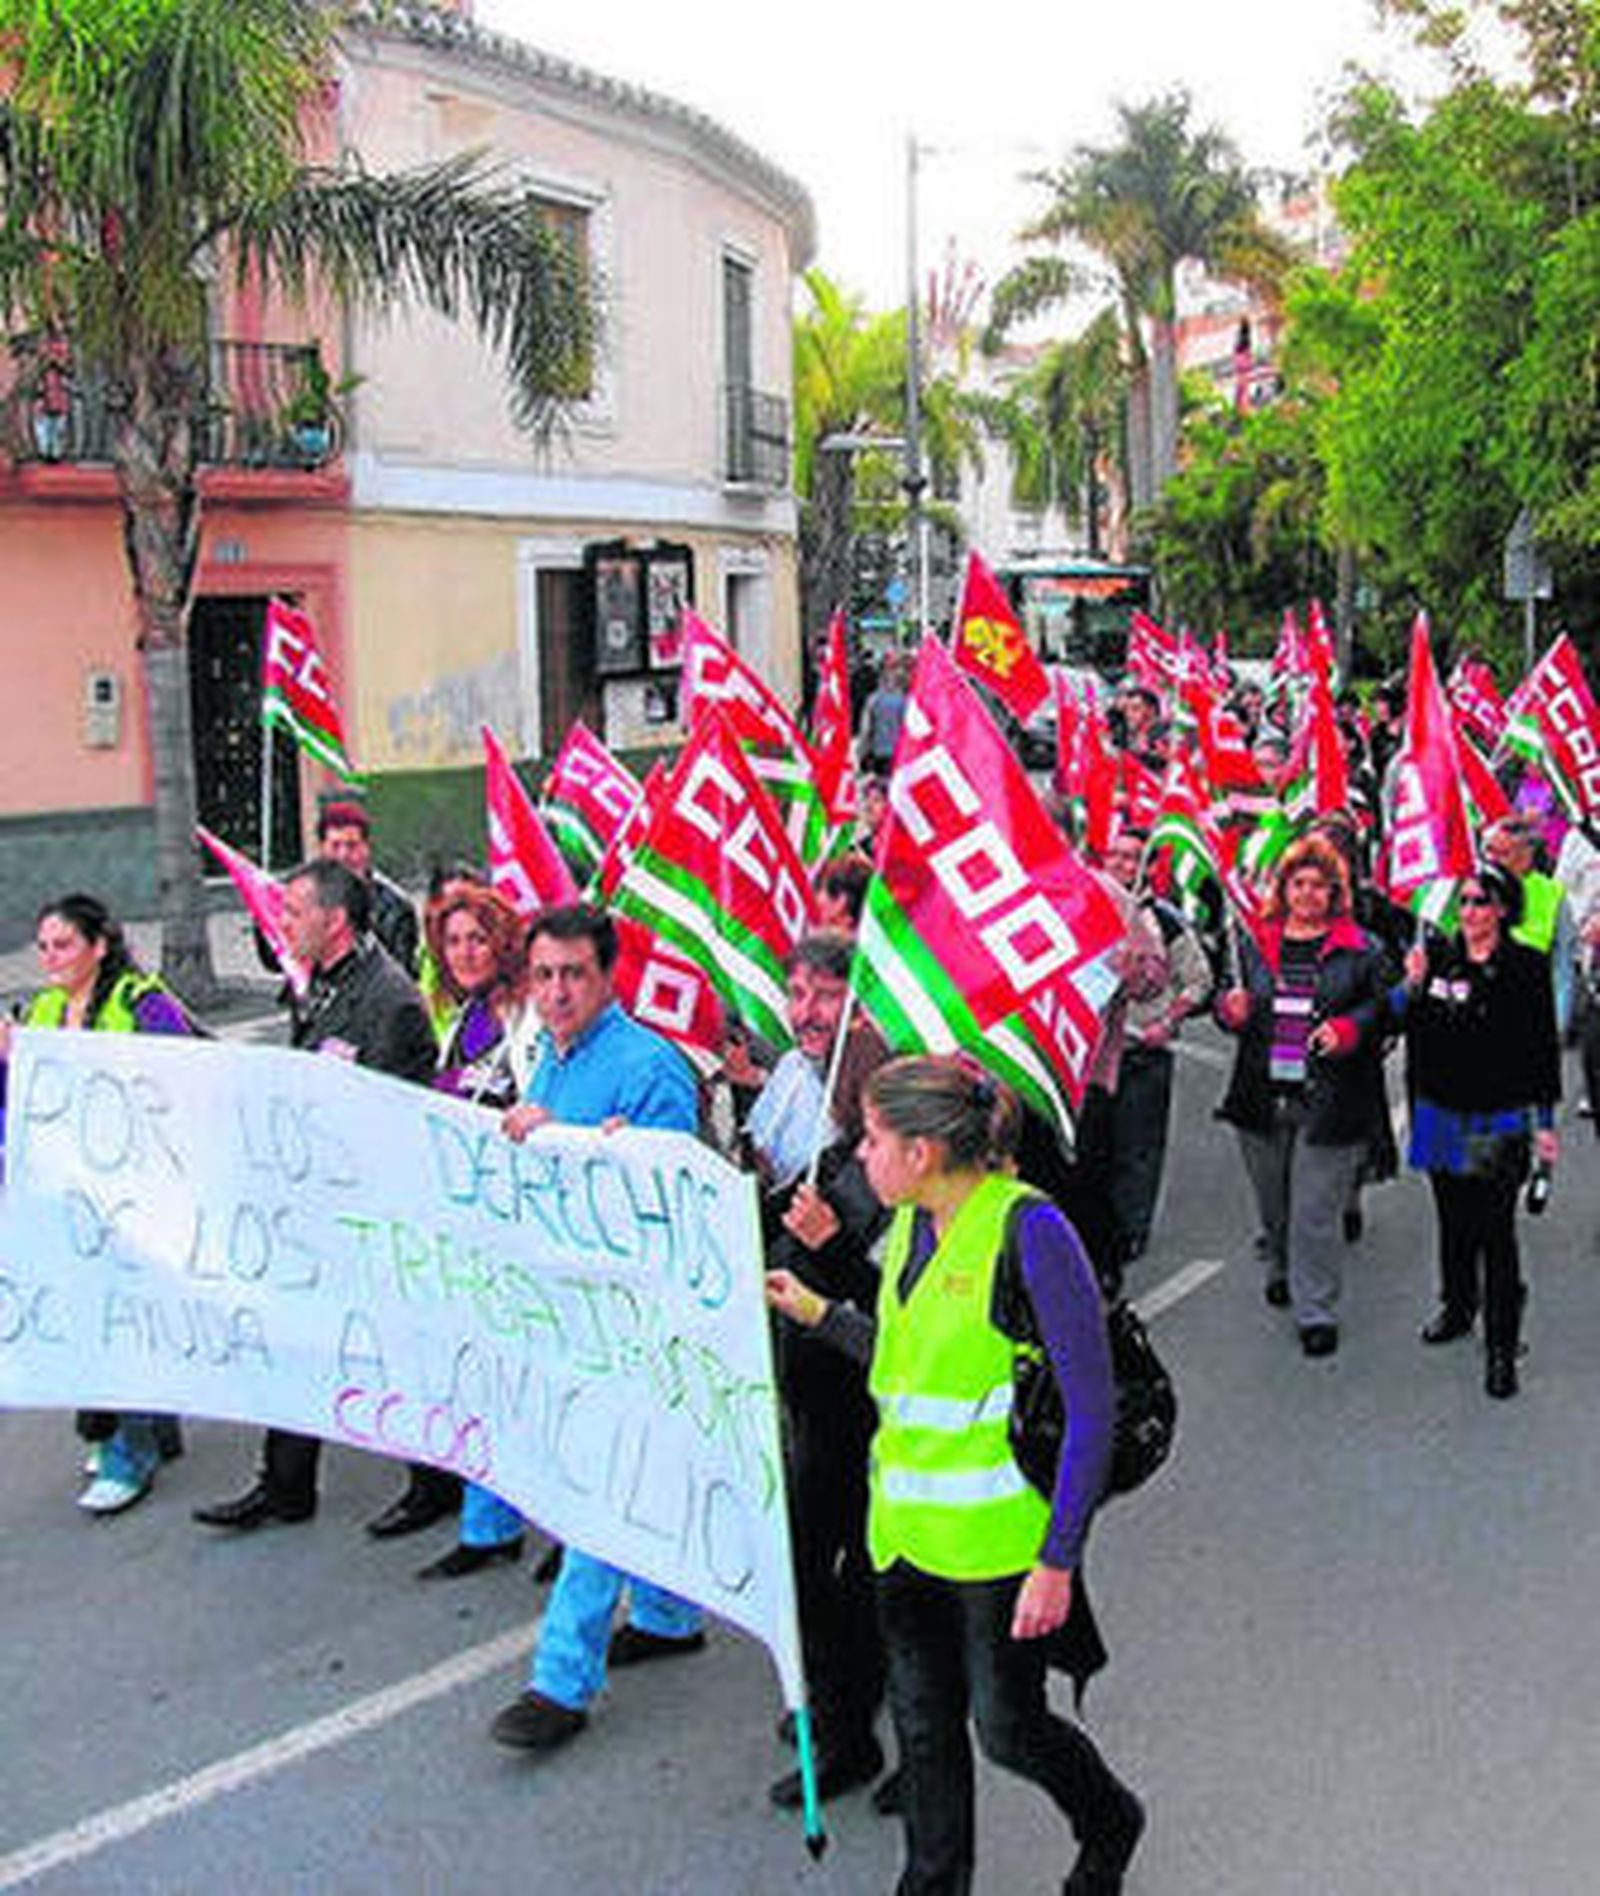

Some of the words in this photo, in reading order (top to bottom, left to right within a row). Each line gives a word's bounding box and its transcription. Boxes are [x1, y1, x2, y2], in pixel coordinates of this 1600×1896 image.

[889, 697, 1080, 994] COO
[22, 1057, 186, 1175] POR
[188, 1201, 322, 1291] LOS
